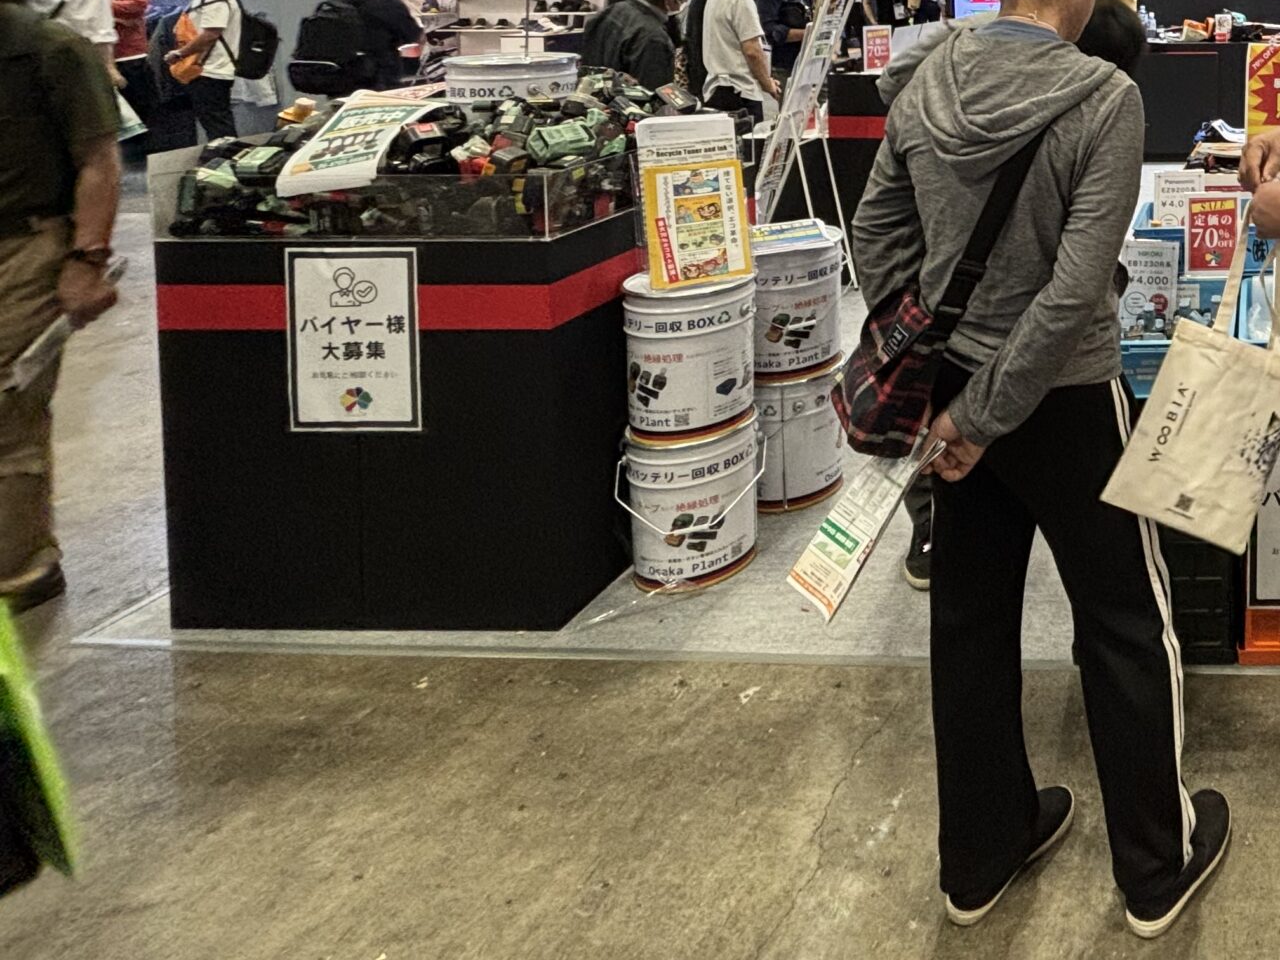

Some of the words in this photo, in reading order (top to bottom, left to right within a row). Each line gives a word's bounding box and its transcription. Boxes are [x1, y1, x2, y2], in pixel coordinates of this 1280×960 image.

[470, 87, 496, 99] BOX
[656, 148, 682, 158] Recycle
[1193, 214, 1232, 227] 定価の
[1217, 239, 1233, 248] OFF
[300, 315, 406, 335] バイヤー様
[625, 317, 683, 333] テリー回収
[687, 314, 716, 331] BOX
[321, 341, 386, 361] 大募集
[788, 352, 820, 367] Plant
[639, 415, 672, 427] Plant
[632, 463, 720, 484] バッテリー回収
[723, 452, 745, 470] BOX
[648, 565, 684, 577] Osaka
[691, 552, 729, 572] Plant
